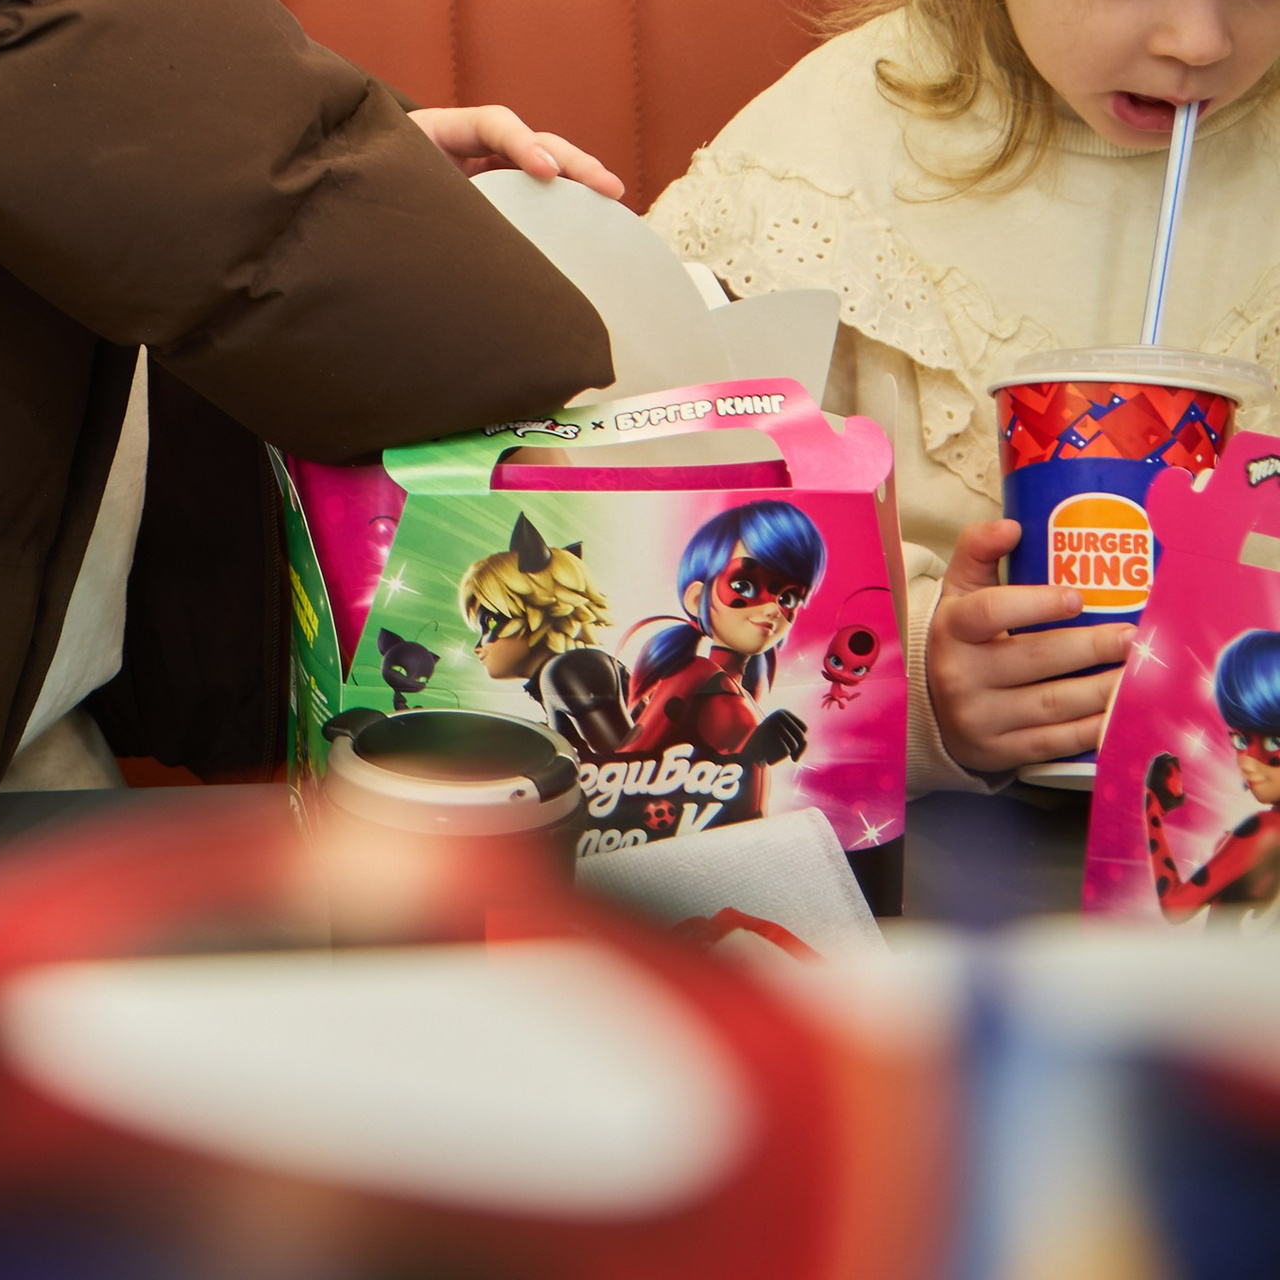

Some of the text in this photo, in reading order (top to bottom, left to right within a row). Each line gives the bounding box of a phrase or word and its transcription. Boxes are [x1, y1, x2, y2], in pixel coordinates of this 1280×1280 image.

[615, 399, 714, 431] БУРГЕР
[715, 393, 786, 418] КИНГ
[1053, 531, 1149, 555] BURGER
[1053, 553, 1150, 587] KING
